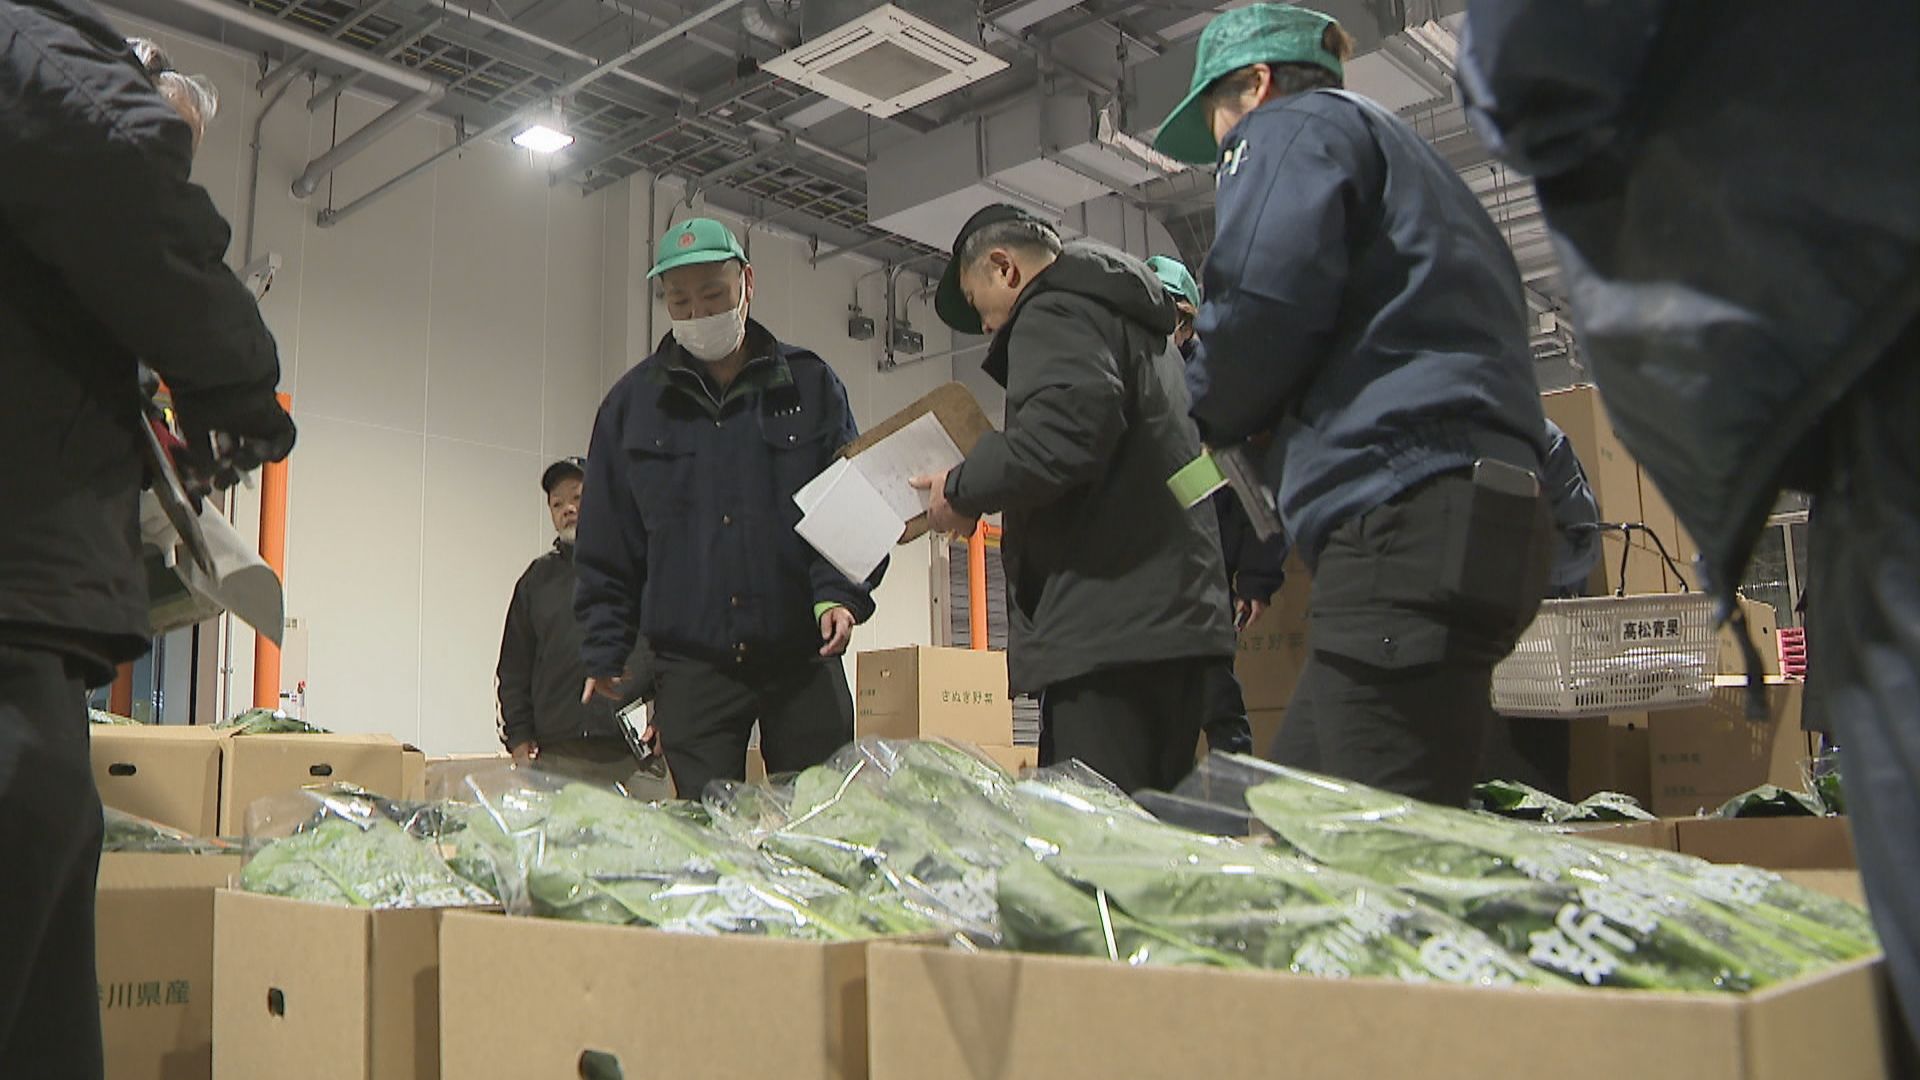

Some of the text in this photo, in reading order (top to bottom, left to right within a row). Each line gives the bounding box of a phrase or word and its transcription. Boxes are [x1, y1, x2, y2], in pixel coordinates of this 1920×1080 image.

[1623, 618, 1680, 641] 高松青果
[941, 689, 994, 705] さぬき野菜
[96, 979, 191, 1009] 川県産
